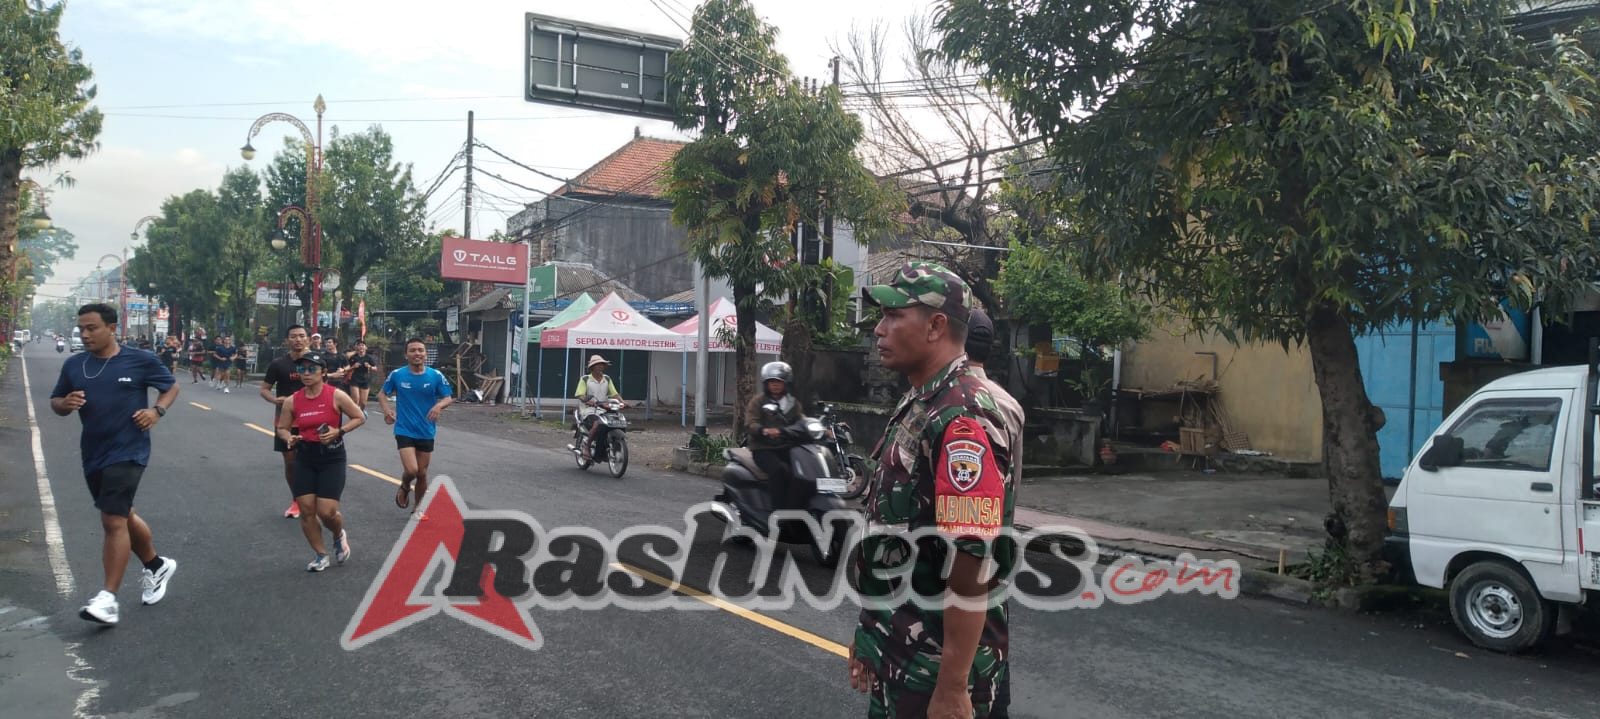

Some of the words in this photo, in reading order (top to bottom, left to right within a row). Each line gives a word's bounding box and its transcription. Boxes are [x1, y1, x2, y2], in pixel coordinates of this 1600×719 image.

[469, 253, 517, 265] TAILG
[575, 337, 608, 345] SEPEDA
[616, 339, 647, 347] MOTOR
[647, 340, 677, 348] LISTRIK
